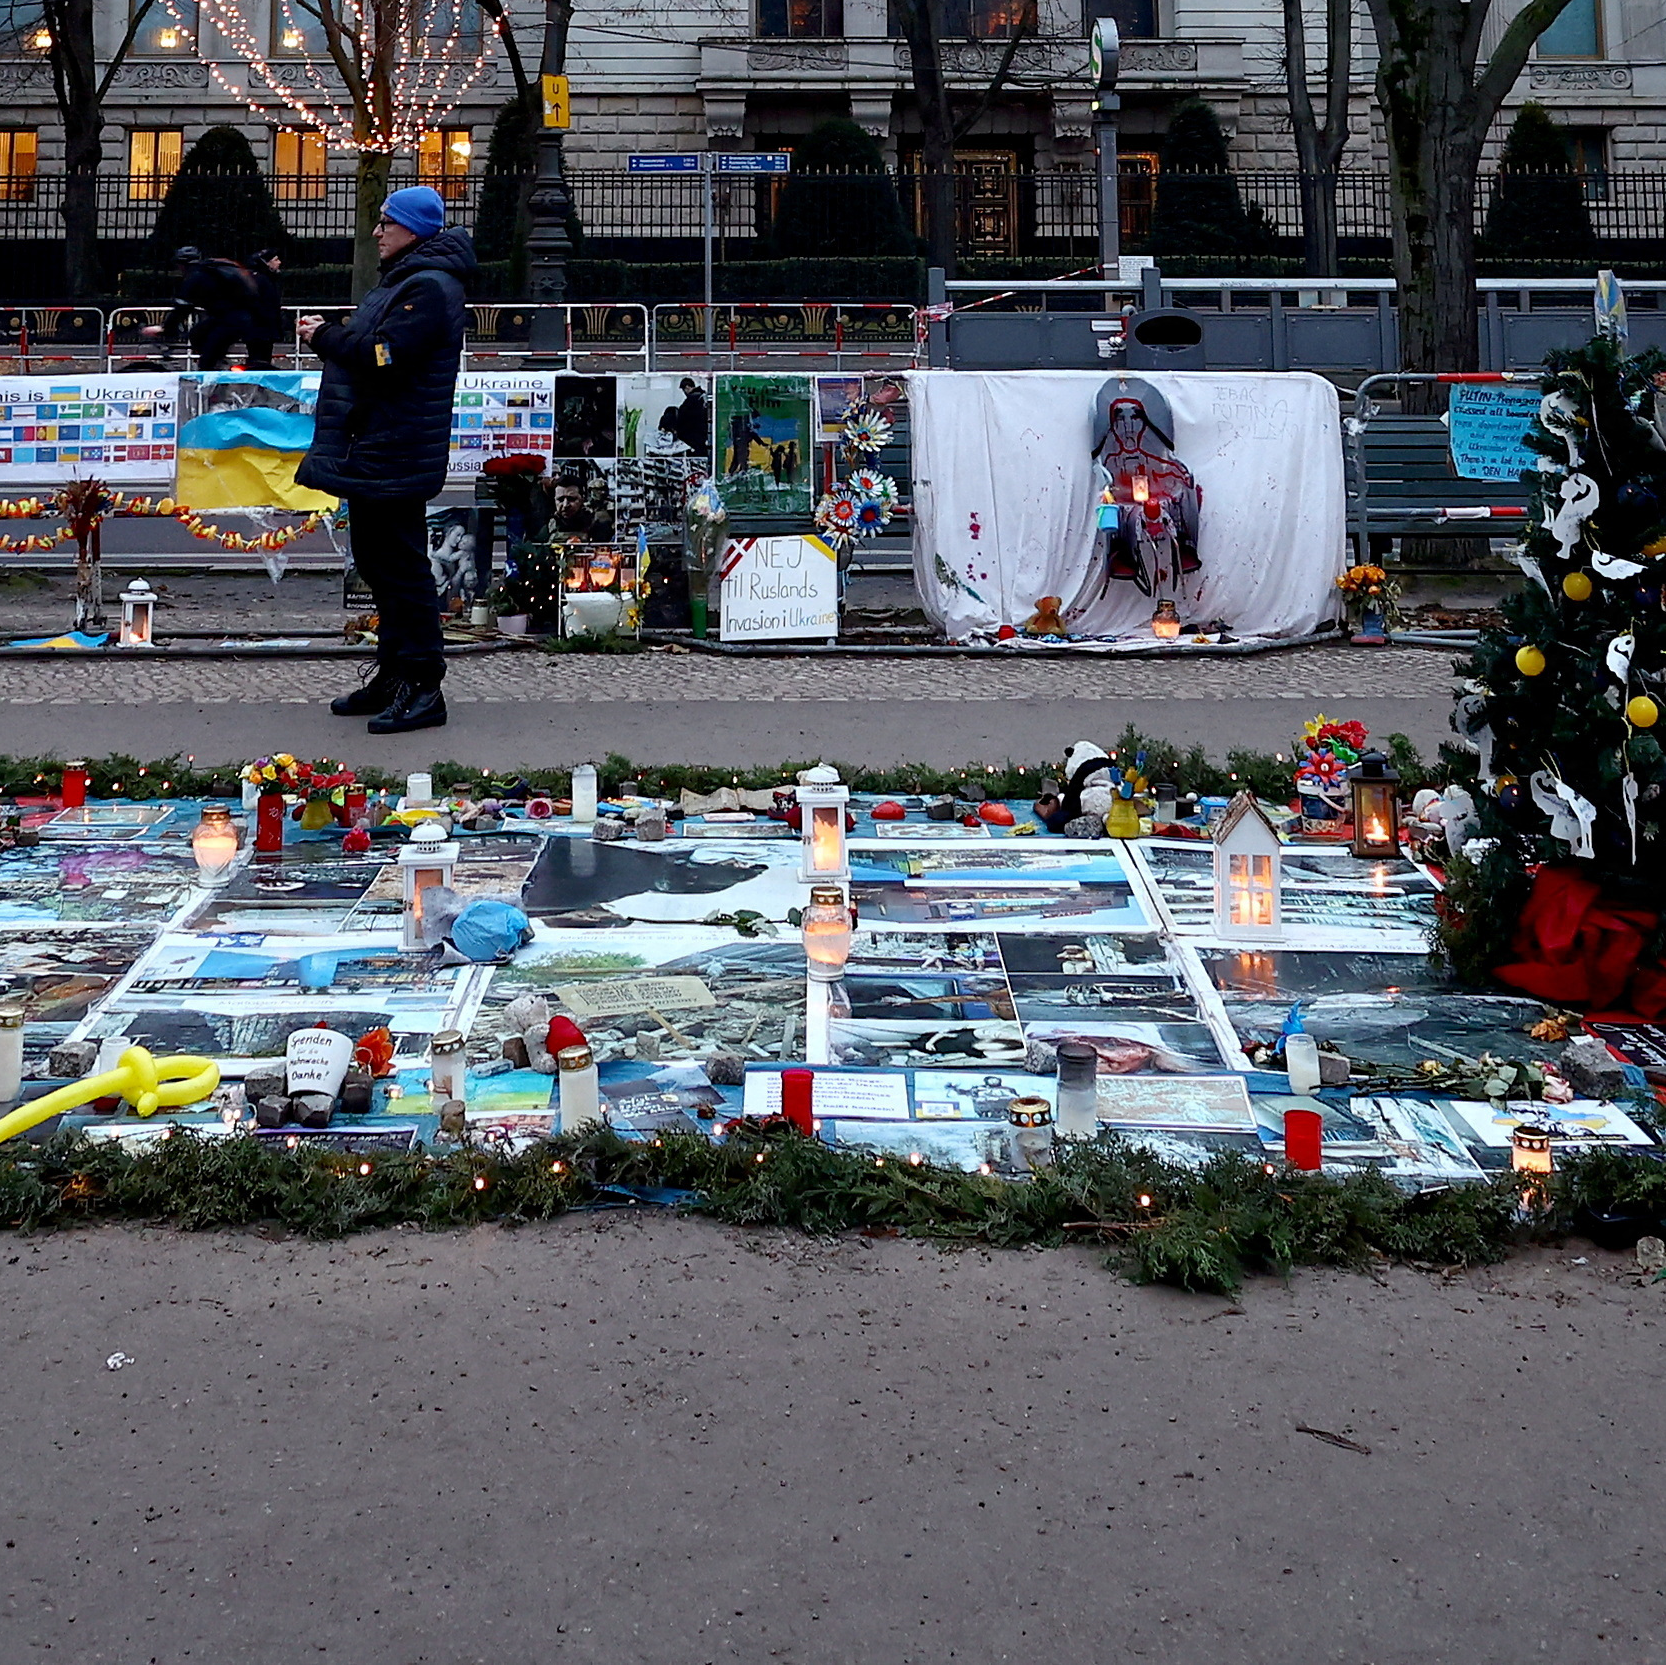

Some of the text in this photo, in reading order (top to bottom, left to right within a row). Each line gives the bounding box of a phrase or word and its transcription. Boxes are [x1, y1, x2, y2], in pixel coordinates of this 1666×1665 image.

[552, 82, 560, 95] U
[463, 377, 544, 390] Ukraine
[28, 389, 44, 402] is
[85, 387, 167, 400] Ukraine
[1489, 407, 1503, 417] all
[1482, 465, 1501, 476] DEN
[755, 538, 803, 569] NEJ
[724, 570, 819, 601] til Ruslands
[725, 605, 835, 633] Invasion i Ukraine
[291, 1032, 332, 1050] Spenden
